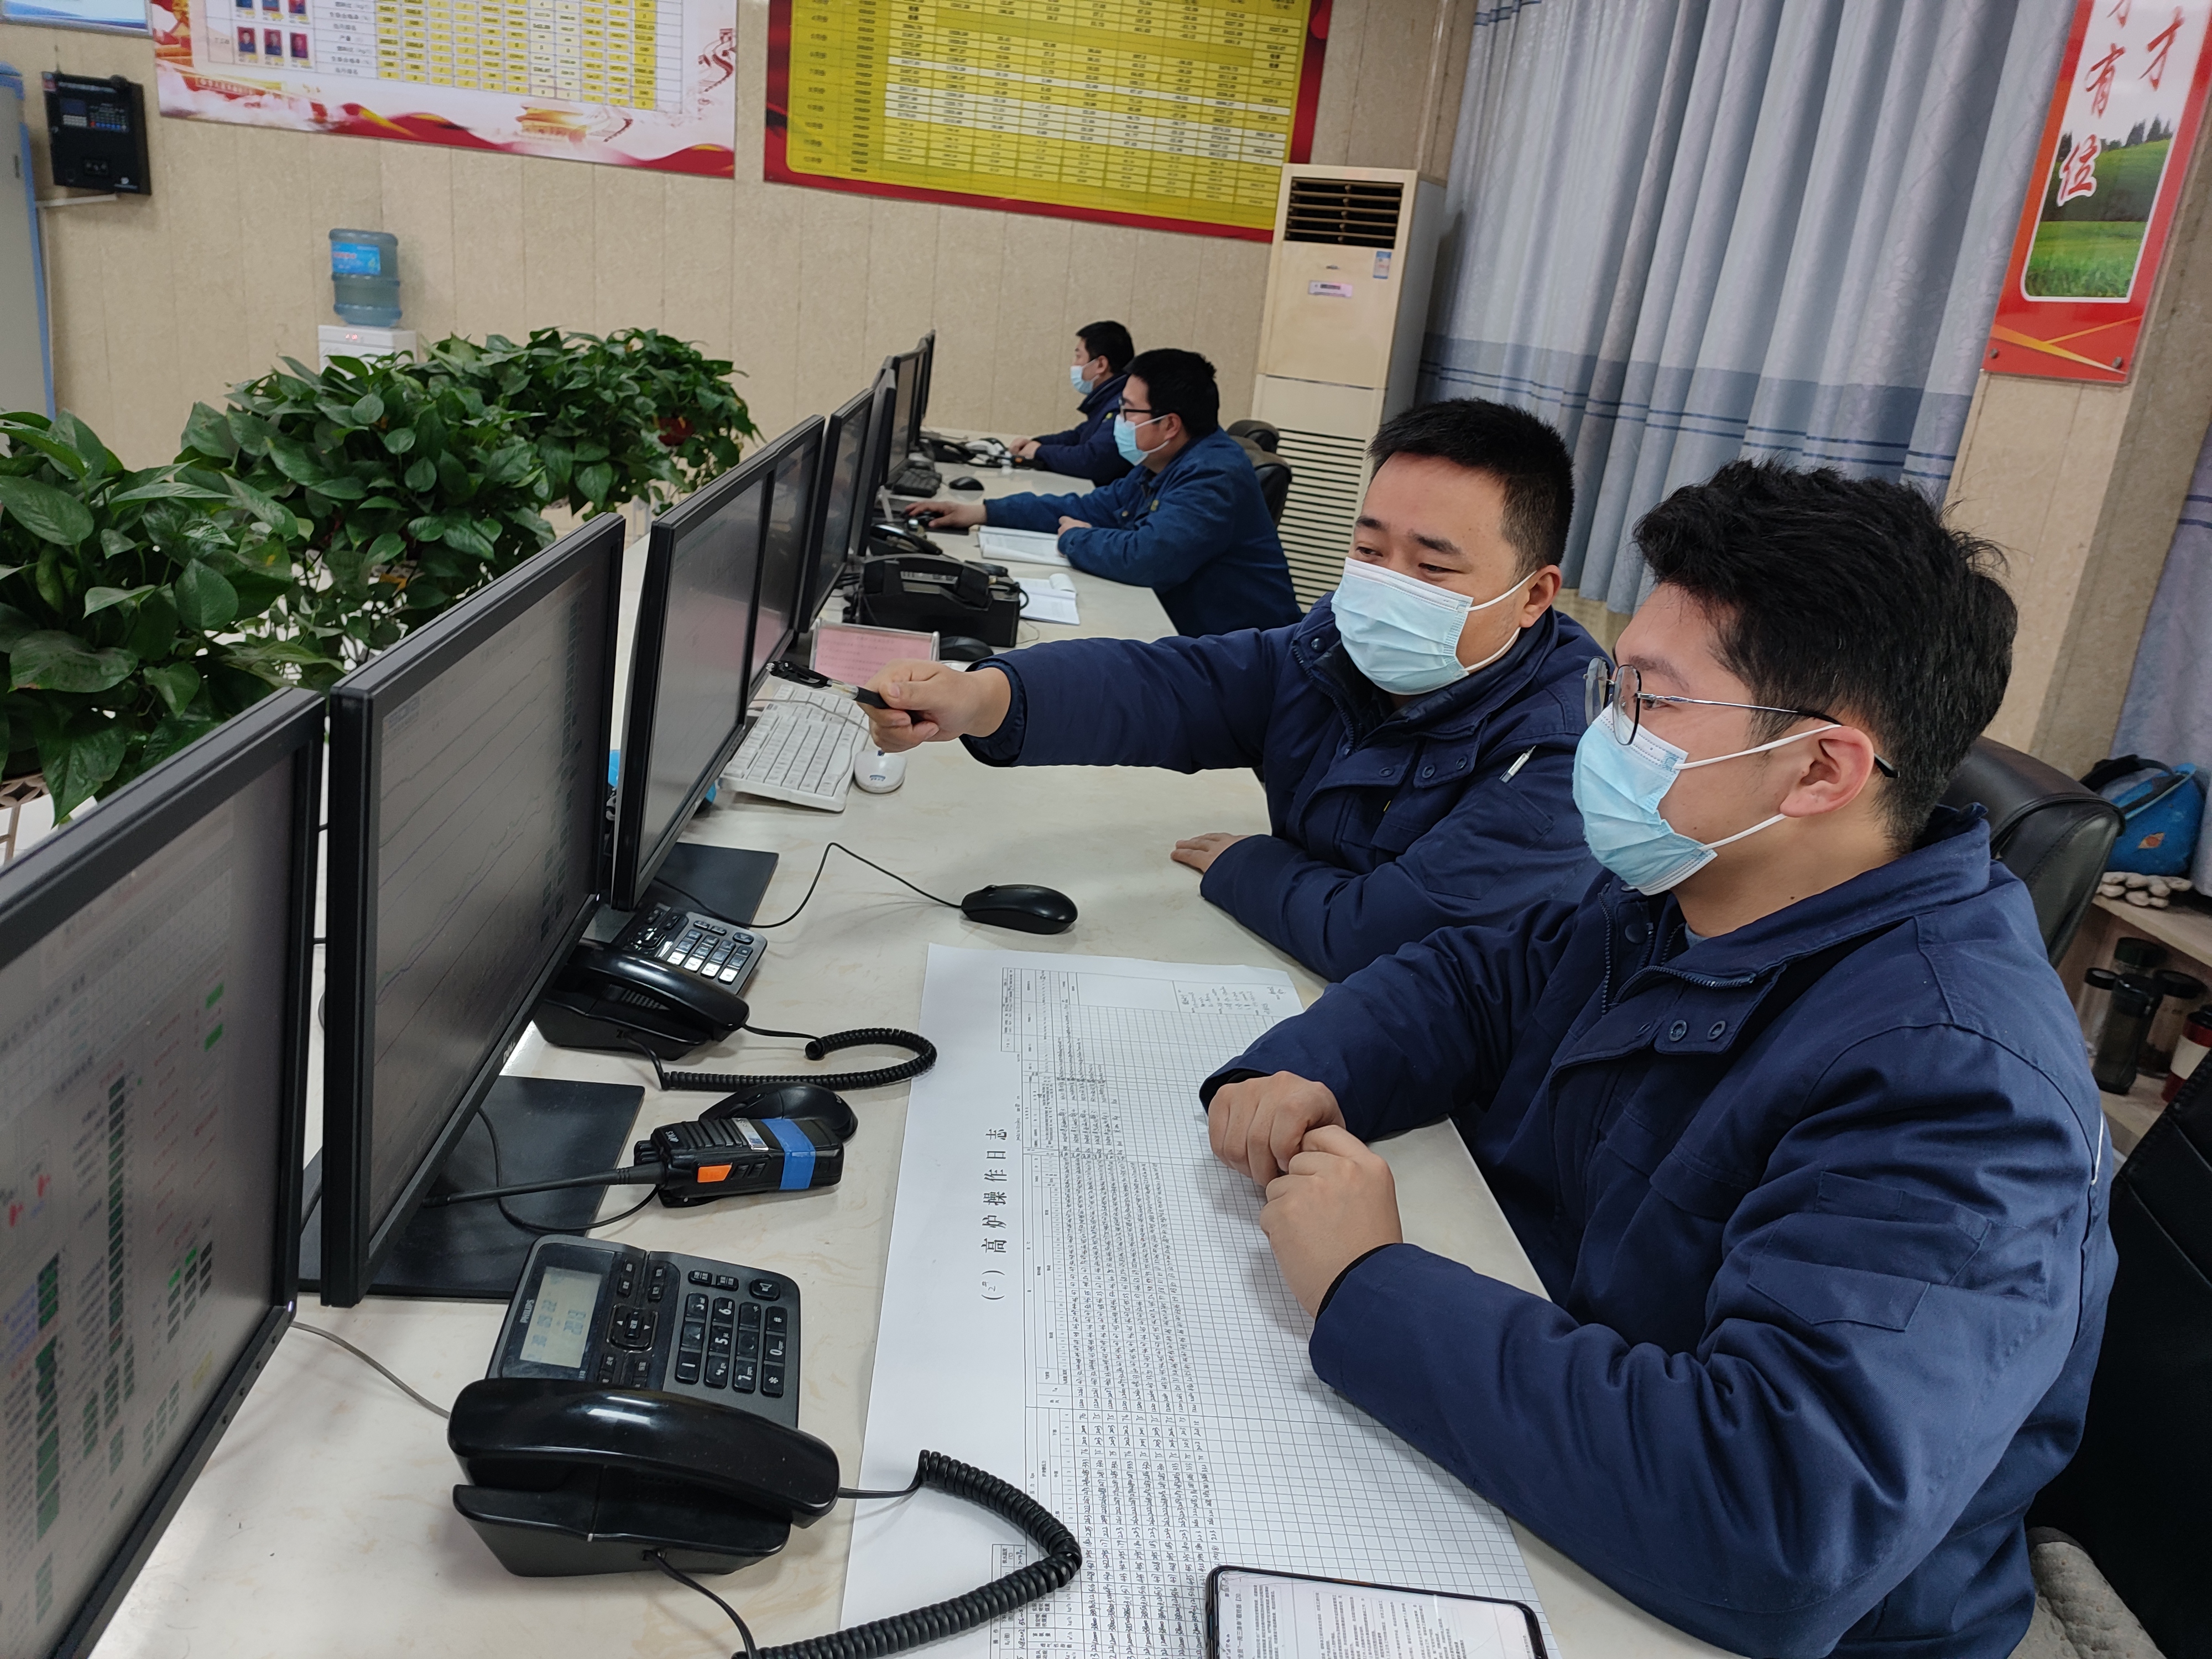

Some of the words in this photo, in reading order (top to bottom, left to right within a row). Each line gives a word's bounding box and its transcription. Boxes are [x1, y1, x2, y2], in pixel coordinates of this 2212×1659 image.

[2138, 6, 2185, 91] 才
[980, 1128, 1008, 1253] 高炉操作日志
[519, 1299, 534, 1323] PHILIPS
